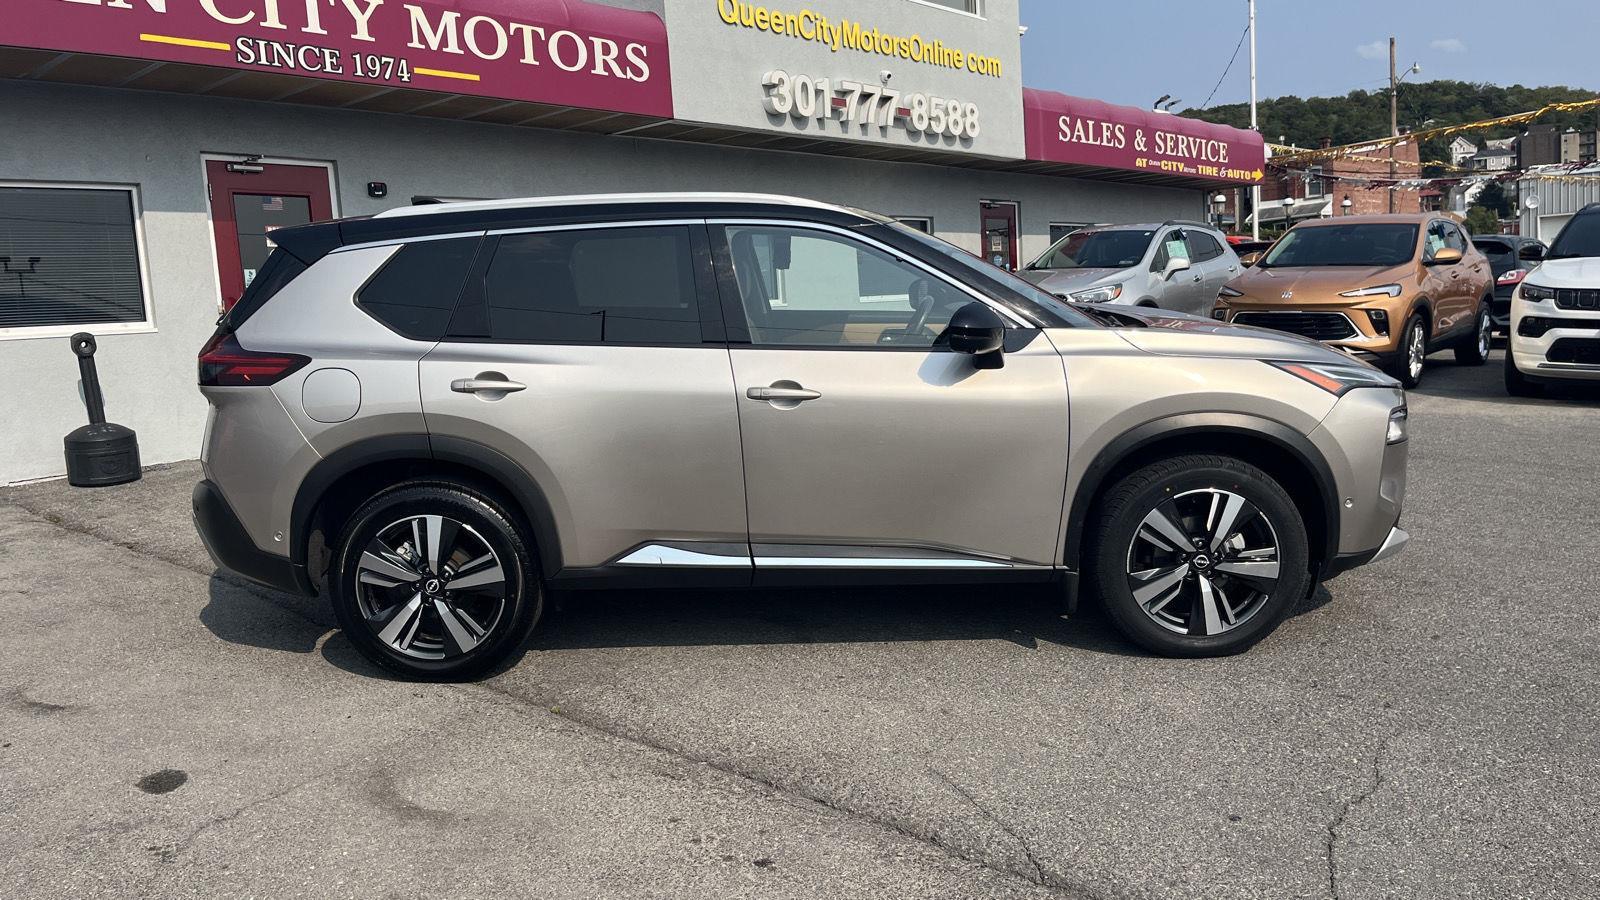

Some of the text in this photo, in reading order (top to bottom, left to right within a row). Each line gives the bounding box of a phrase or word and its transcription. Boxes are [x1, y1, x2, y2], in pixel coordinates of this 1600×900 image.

[235, 36, 411, 82] SINCE 1974
[403, 3, 651, 83] MOTORS
[761, 69, 980, 138] 301-777-8588
[1058, 115, 1229, 164] SALES & SERVICE
[1135, 157, 1148, 168] AT
[1161, 159, 1185, 172] CITY
[1197, 164, 1219, 177] TIRE
[1227, 168, 1251, 180] AUTO
